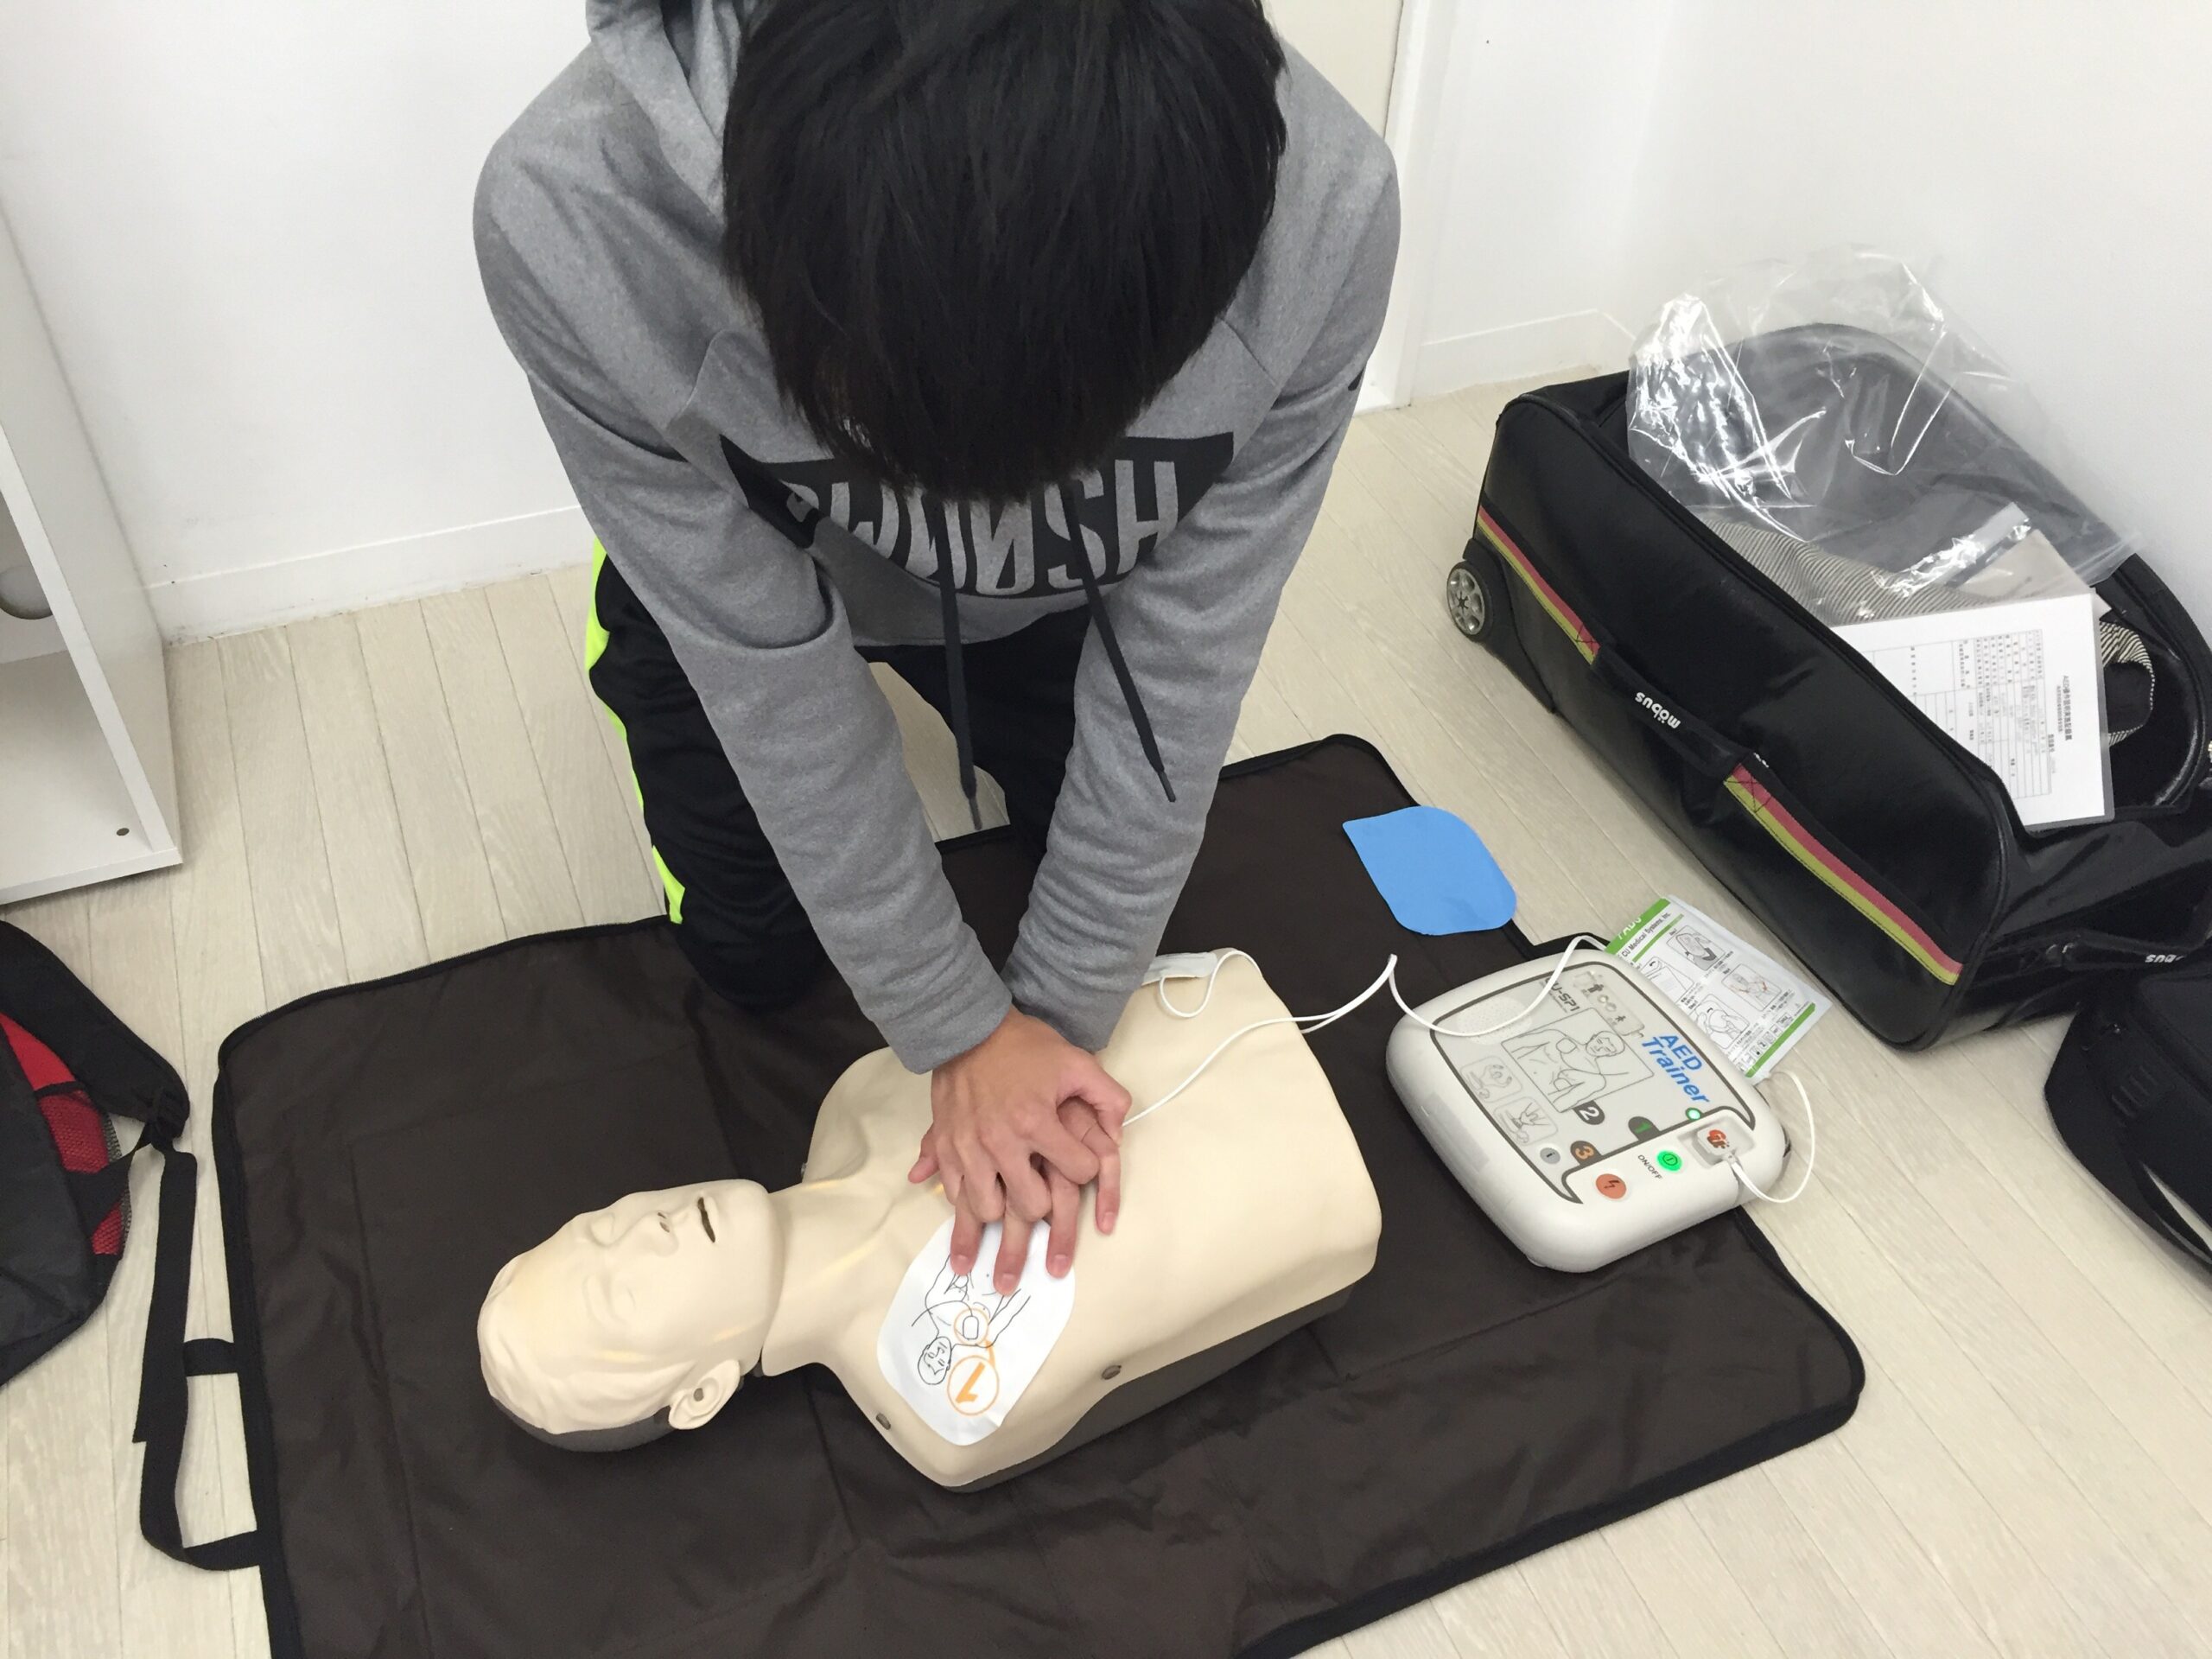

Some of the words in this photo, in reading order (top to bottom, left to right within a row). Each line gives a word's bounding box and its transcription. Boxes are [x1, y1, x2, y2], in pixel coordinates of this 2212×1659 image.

[1621, 948, 1631, 957] CU
[1628, 931, 1647, 951] Medical
[1659, 1035, 1702, 1071] AED
[1642, 1036, 1710, 1103] Trainer
[1579, 1105, 1599, 1121] 2
[1574, 1145, 1595, 1160] 3
[1637, 1154, 1663, 1179] ON/OFF
[955, 1361, 986, 1404] 1
